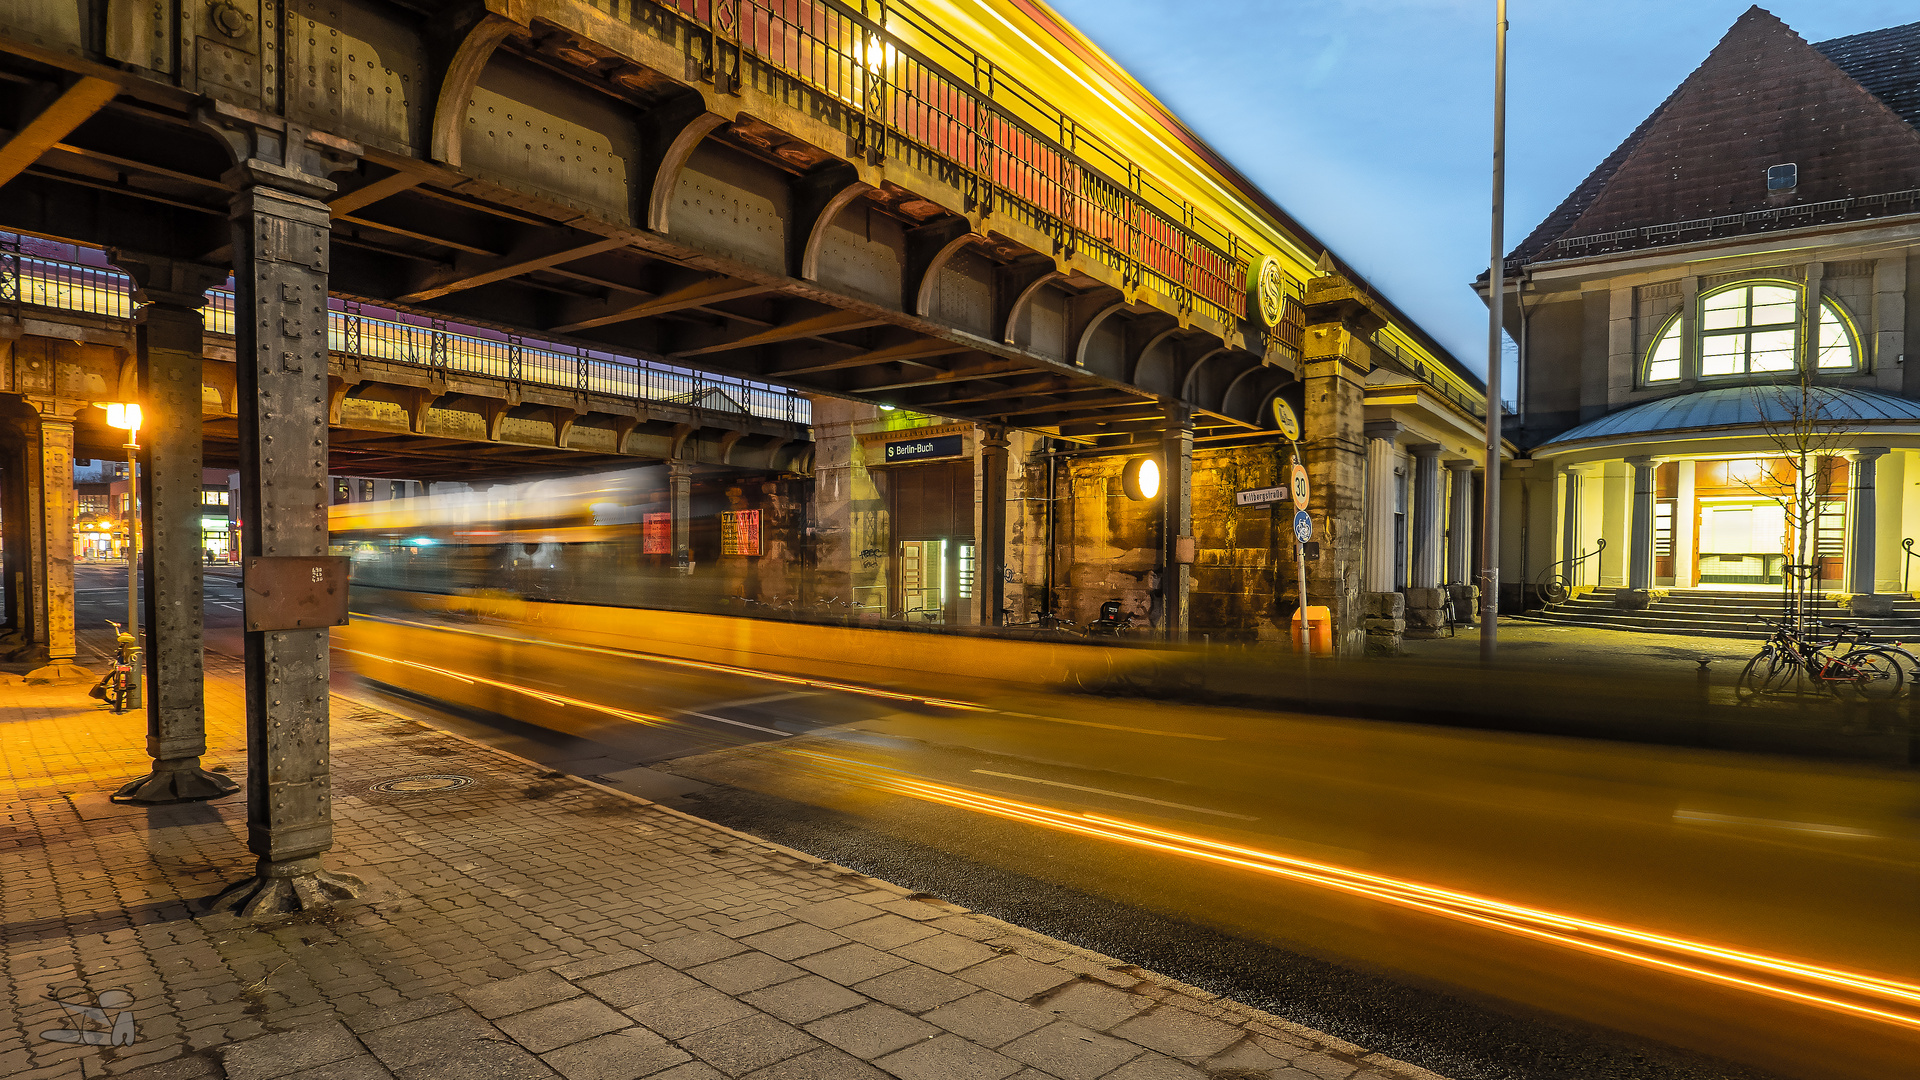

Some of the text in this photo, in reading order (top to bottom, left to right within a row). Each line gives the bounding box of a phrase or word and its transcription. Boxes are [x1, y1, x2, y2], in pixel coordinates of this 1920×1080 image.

[887, 443, 934, 457] S Berlin-Buch
[1295, 477, 1306, 497] 30
